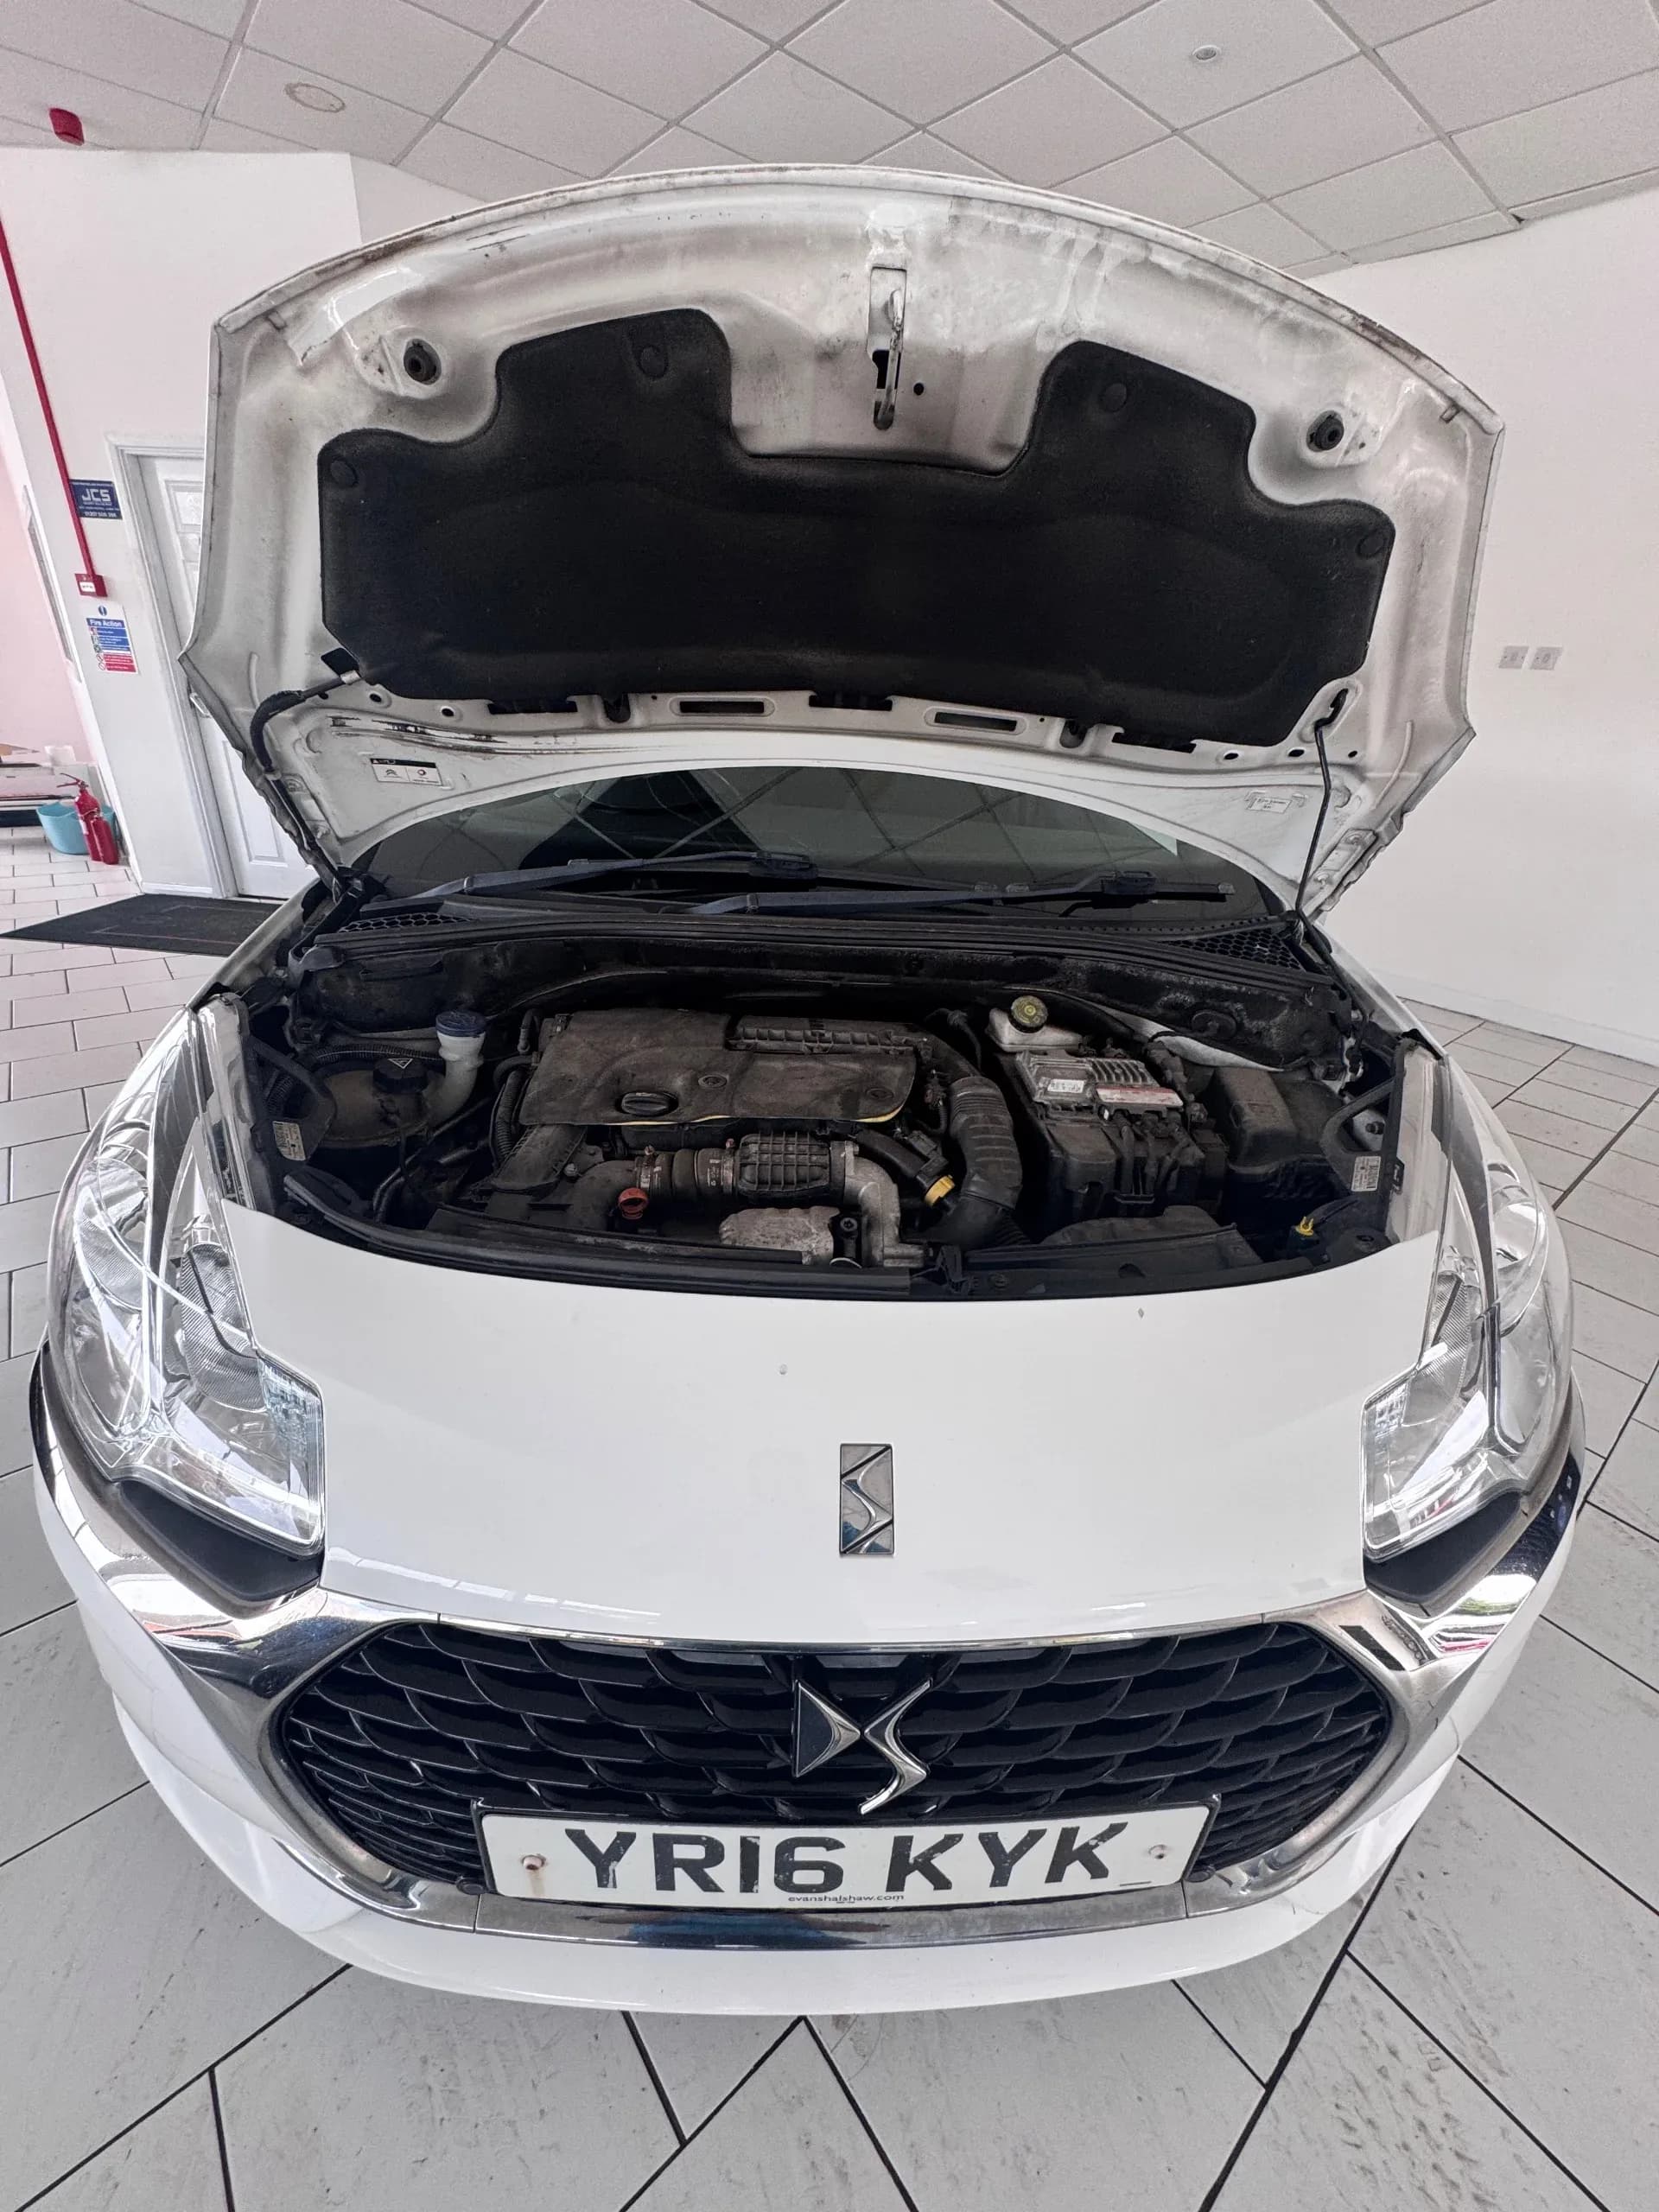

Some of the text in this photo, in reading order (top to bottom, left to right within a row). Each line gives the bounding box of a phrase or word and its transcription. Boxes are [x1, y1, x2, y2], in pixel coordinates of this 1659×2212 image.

[81, 488, 111, 502] JCS
[564, 1822, 1128, 1894] YR16 KYK
